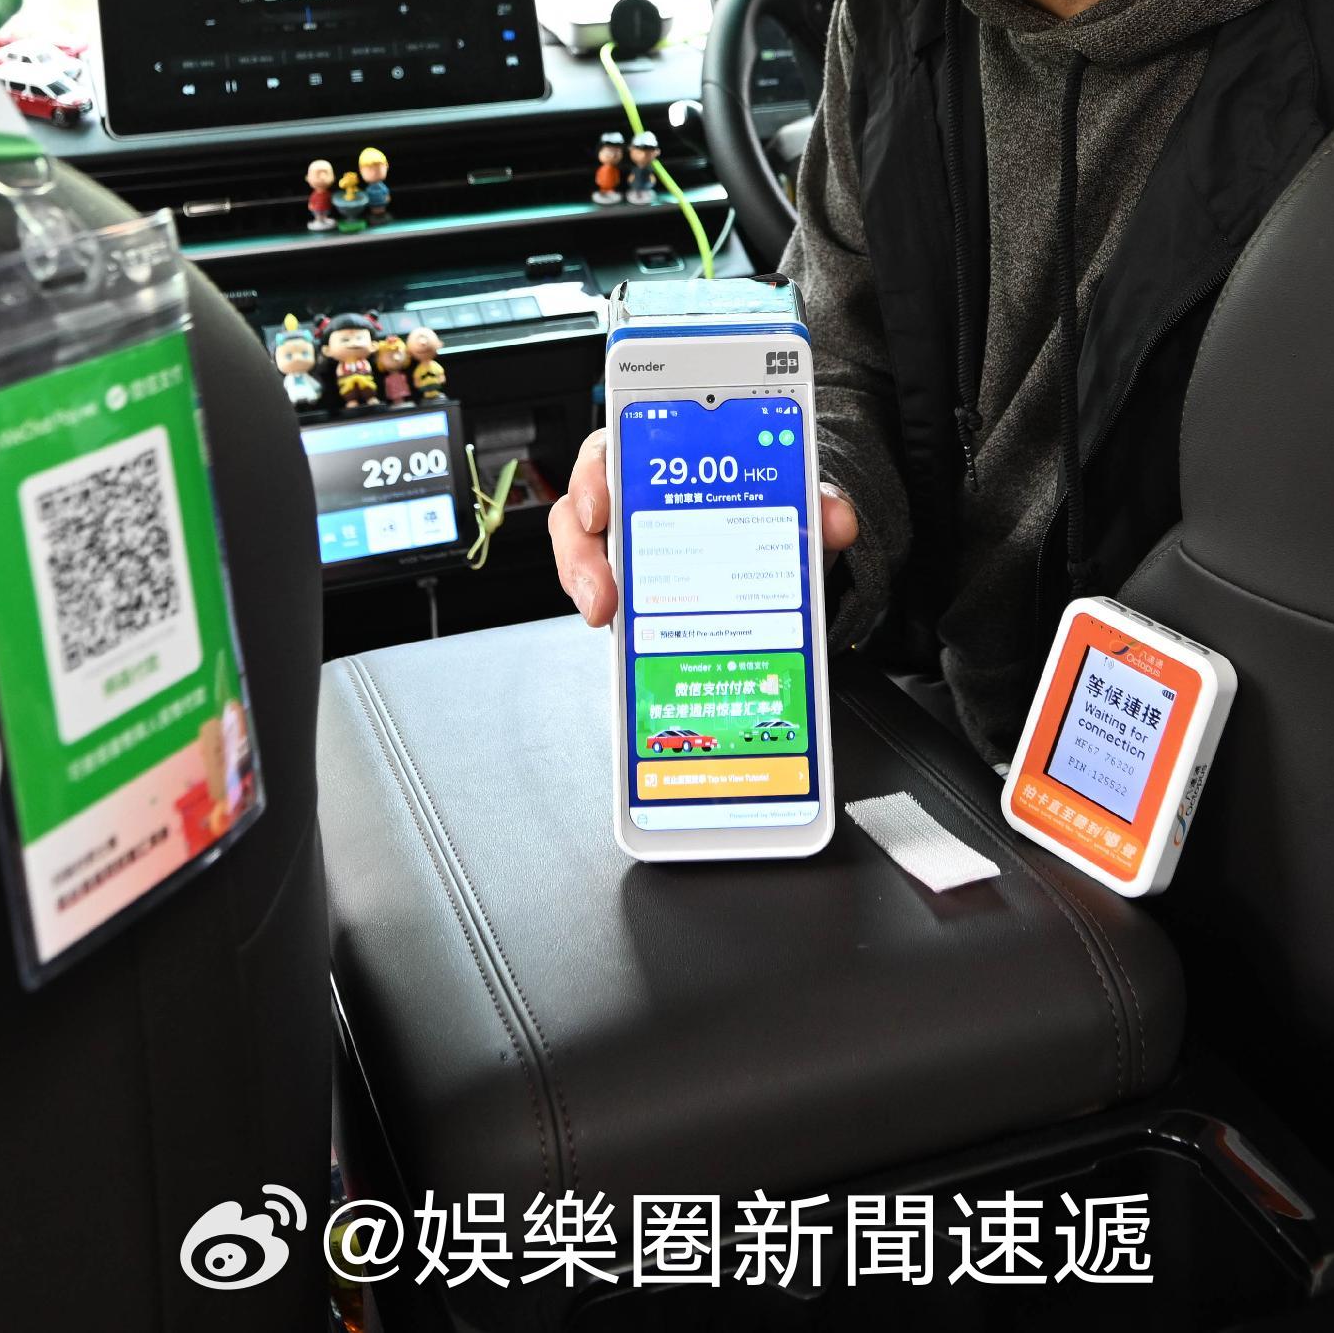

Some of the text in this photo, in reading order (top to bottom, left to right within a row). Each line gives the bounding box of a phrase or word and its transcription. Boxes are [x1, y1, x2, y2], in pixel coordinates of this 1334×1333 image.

[618, 361, 666, 373] Wonder
[766, 351, 799, 374] JCB
[362, 448, 448, 488] 29.00
[649, 455, 778, 485] 29.00 HKD
[705, 492, 741, 503] Current
[743, 492, 764, 502] Fare
[679, 662, 712, 673] Wonder
[1125, 653, 1162, 678] Octopus
[675, 680, 756, 698] 微信支付付款
[1085, 673, 1163, 730] 等候連接
[1083, 700, 1149, 744] Waiting for
[1077, 717, 1147, 761] connection
